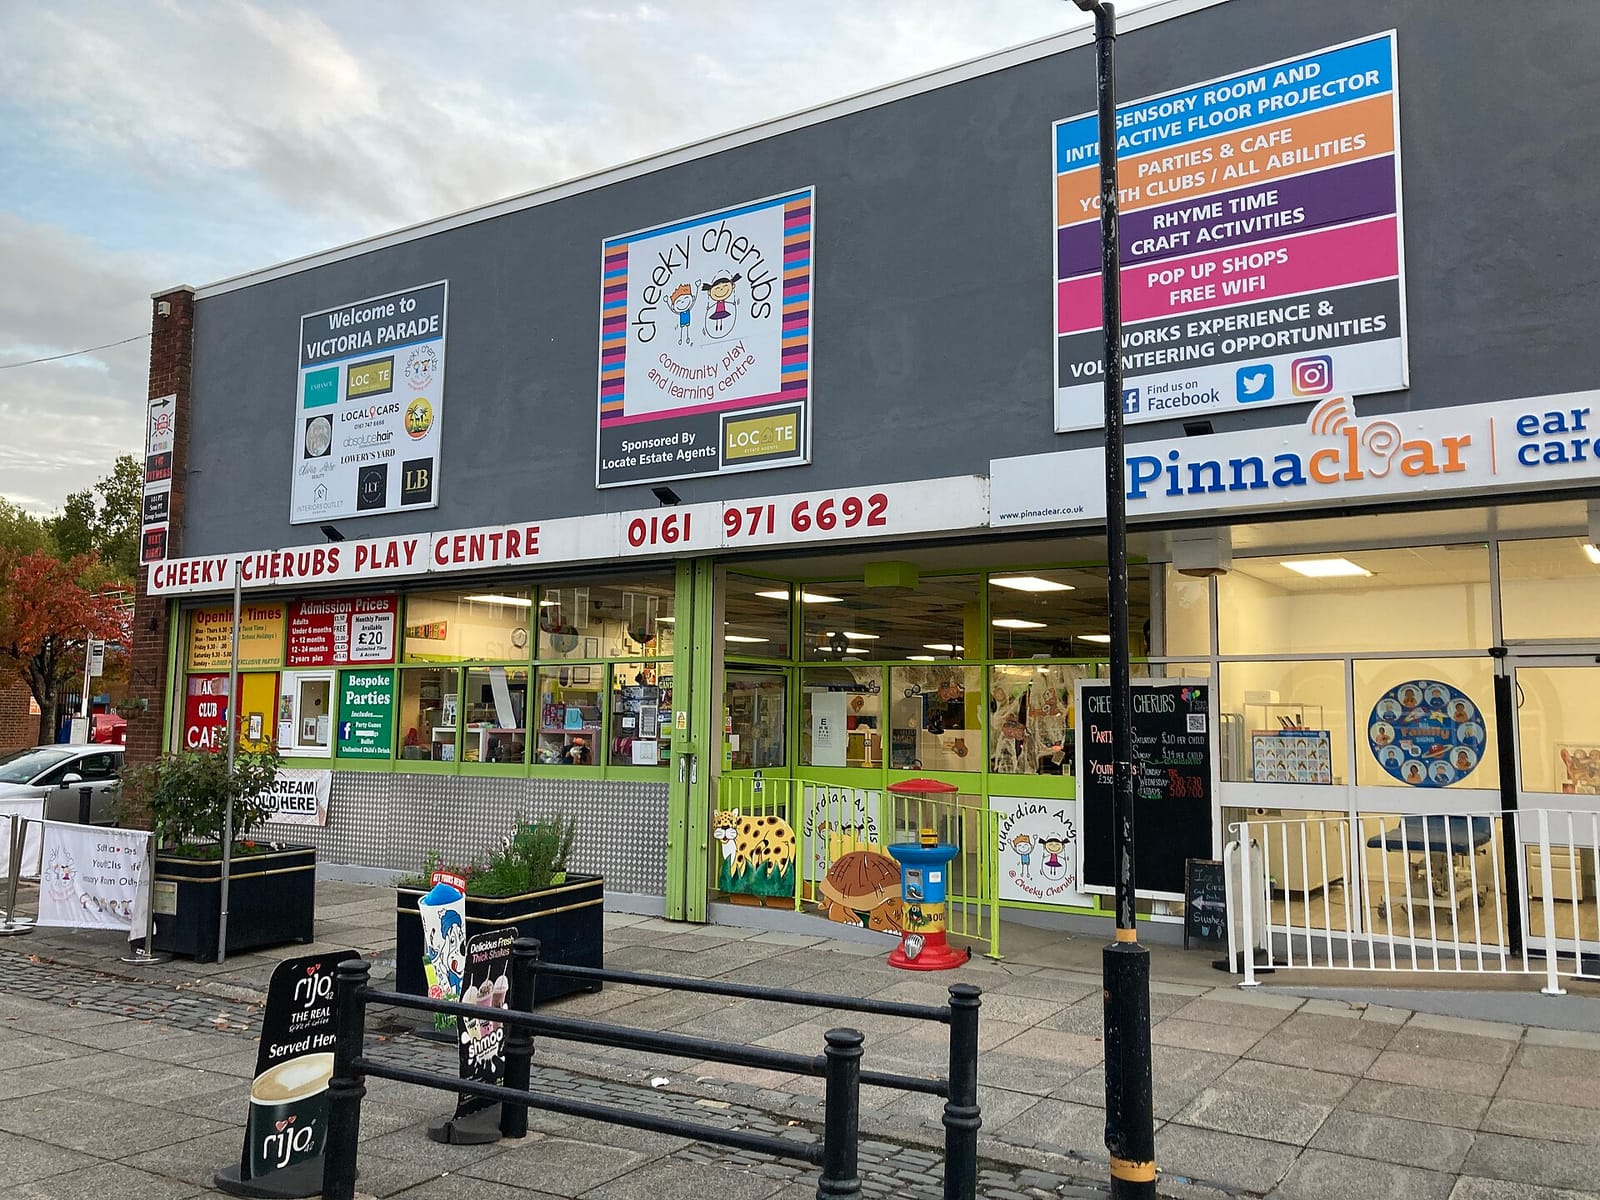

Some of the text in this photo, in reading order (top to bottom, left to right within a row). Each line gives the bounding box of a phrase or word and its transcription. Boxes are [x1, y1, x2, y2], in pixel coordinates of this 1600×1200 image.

[1116, 62, 1321, 129] SENSORY ROOM AND
[1066, 70, 1380, 163] INTACTIVE FLOOR PROJECTOR
[1138, 128, 1293, 178] PARTIES & CAFE
[1080, 185, 1141, 213] YOTH
[1146, 168, 1206, 197] CLUBS
[1223, 160, 1260, 181] ALL
[1266, 133, 1367, 171] ABILITIES
[1153, 190, 1279, 230] RHYME TIME
[1131, 207, 1305, 256] CRAFT ACTIVITIES
[1147, 248, 1289, 288] POP UP SHOPS
[632, 220, 778, 343] cheeky cherubs
[1170, 276, 1266, 306] FREE WIFI
[328, 297, 416, 330] Welcome to
[1187, 303, 1311, 338] EXPERIENCE
[1318, 301, 1334, 316] &
[307, 315, 439, 360] VICTORIA PARADE
[1071, 315, 1387, 378] VOLNTEERING OPPORTUNITIES
[658, 340, 746, 380] community play
[647, 354, 756, 401] and learning centre
[1147, 379, 1198, 395] Find us on
[341, 403, 400, 422] LOCAL CARS
[1148, 388, 1220, 412] Facebook
[1516, 407, 1591, 437] ear
[377, 448, 396, 459] YARD
[621, 431, 696, 453] Sponsored By
[602, 445, 716, 470] Locate Estate Agents
[405, 469, 429, 491] LB
[628, 493, 889, 547] 0161 971 6692
[999, 505, 1084, 520] www.pinnaclear.co.uk
[153, 526, 540, 589] CHEEKY CHERUBS PLAY CENTRE
[248, 608, 282, 621] Times
[300, 598, 389, 615] Admission Prices
[358, 631, 383, 645] £20
[349, 675, 390, 688] Bespoke
[198, 703, 218, 717] CLUB
[345, 691, 391, 705] Parties
[1088, 696, 1112, 713] CHEE
[1133, 694, 1176, 713] CHERUBS
[821, 718, 827, 726] E
[1090, 725, 1113, 743] PARTI
[272, 780, 315, 795] CREAM
[254, 795, 315, 811] OLD HERE
[1053, 809, 1076, 839] Ang
[1015, 878, 1043, 899] Cheeky
[1046, 874, 1075, 897] Cherubs
[470, 940, 497, 954] Delicious
[472, 948, 510, 964] Thick Shakes
[294, 966, 333, 1008] rijo
[291, 1006, 330, 1024] THE REAL
[269, 1036, 310, 1058] Served
[469, 1028, 503, 1058] shmoo
[263, 1122, 315, 1169] rijo
